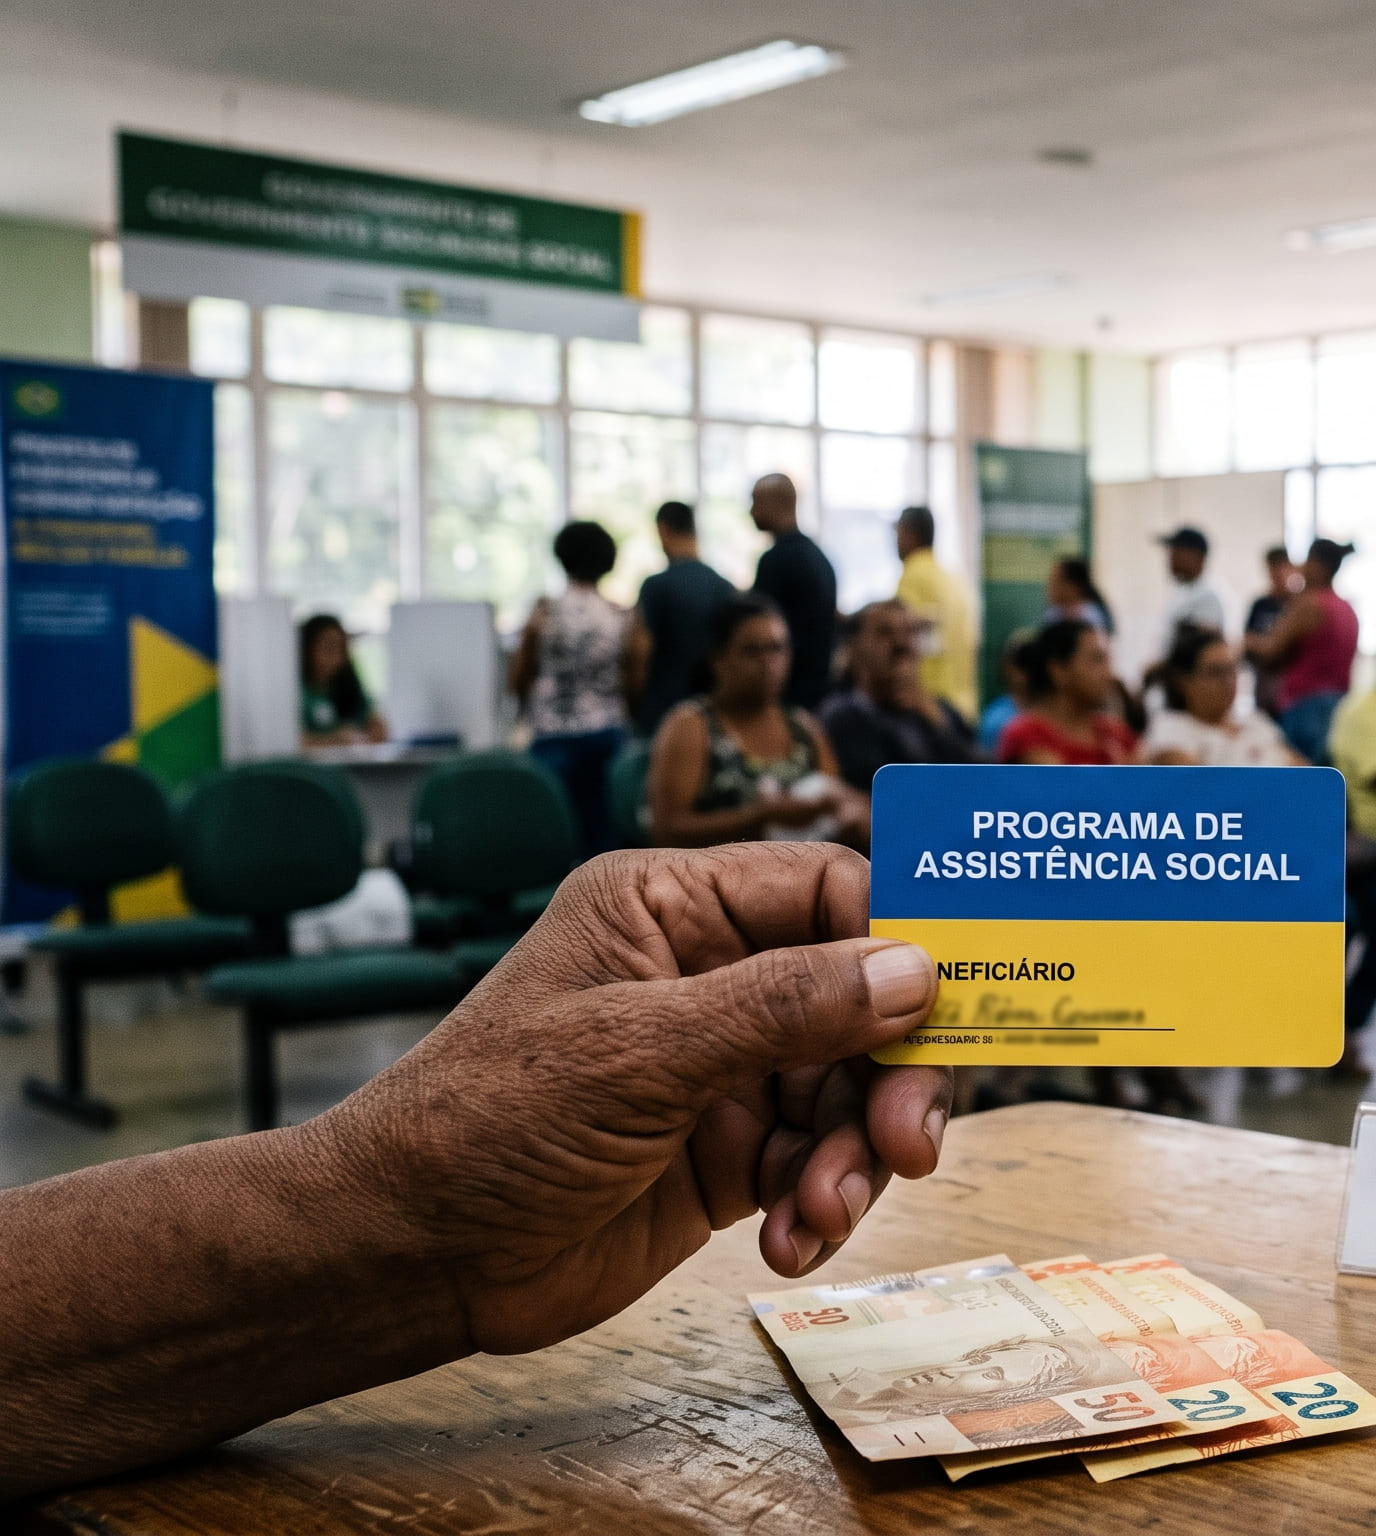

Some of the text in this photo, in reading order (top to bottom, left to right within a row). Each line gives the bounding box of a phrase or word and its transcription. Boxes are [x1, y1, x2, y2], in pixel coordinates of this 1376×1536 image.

[974, 812, 1242, 839] PROGRAMA DE
[915, 846, 1299, 880] ASSISTÊNCIA SOCIAL
[938, 958, 1074, 981] NEFICIÁRIO
[1073, 1391, 1156, 1422] 50
[1166, 1389, 1247, 1422] 20
[1271, 1382, 1360, 1420] 20
